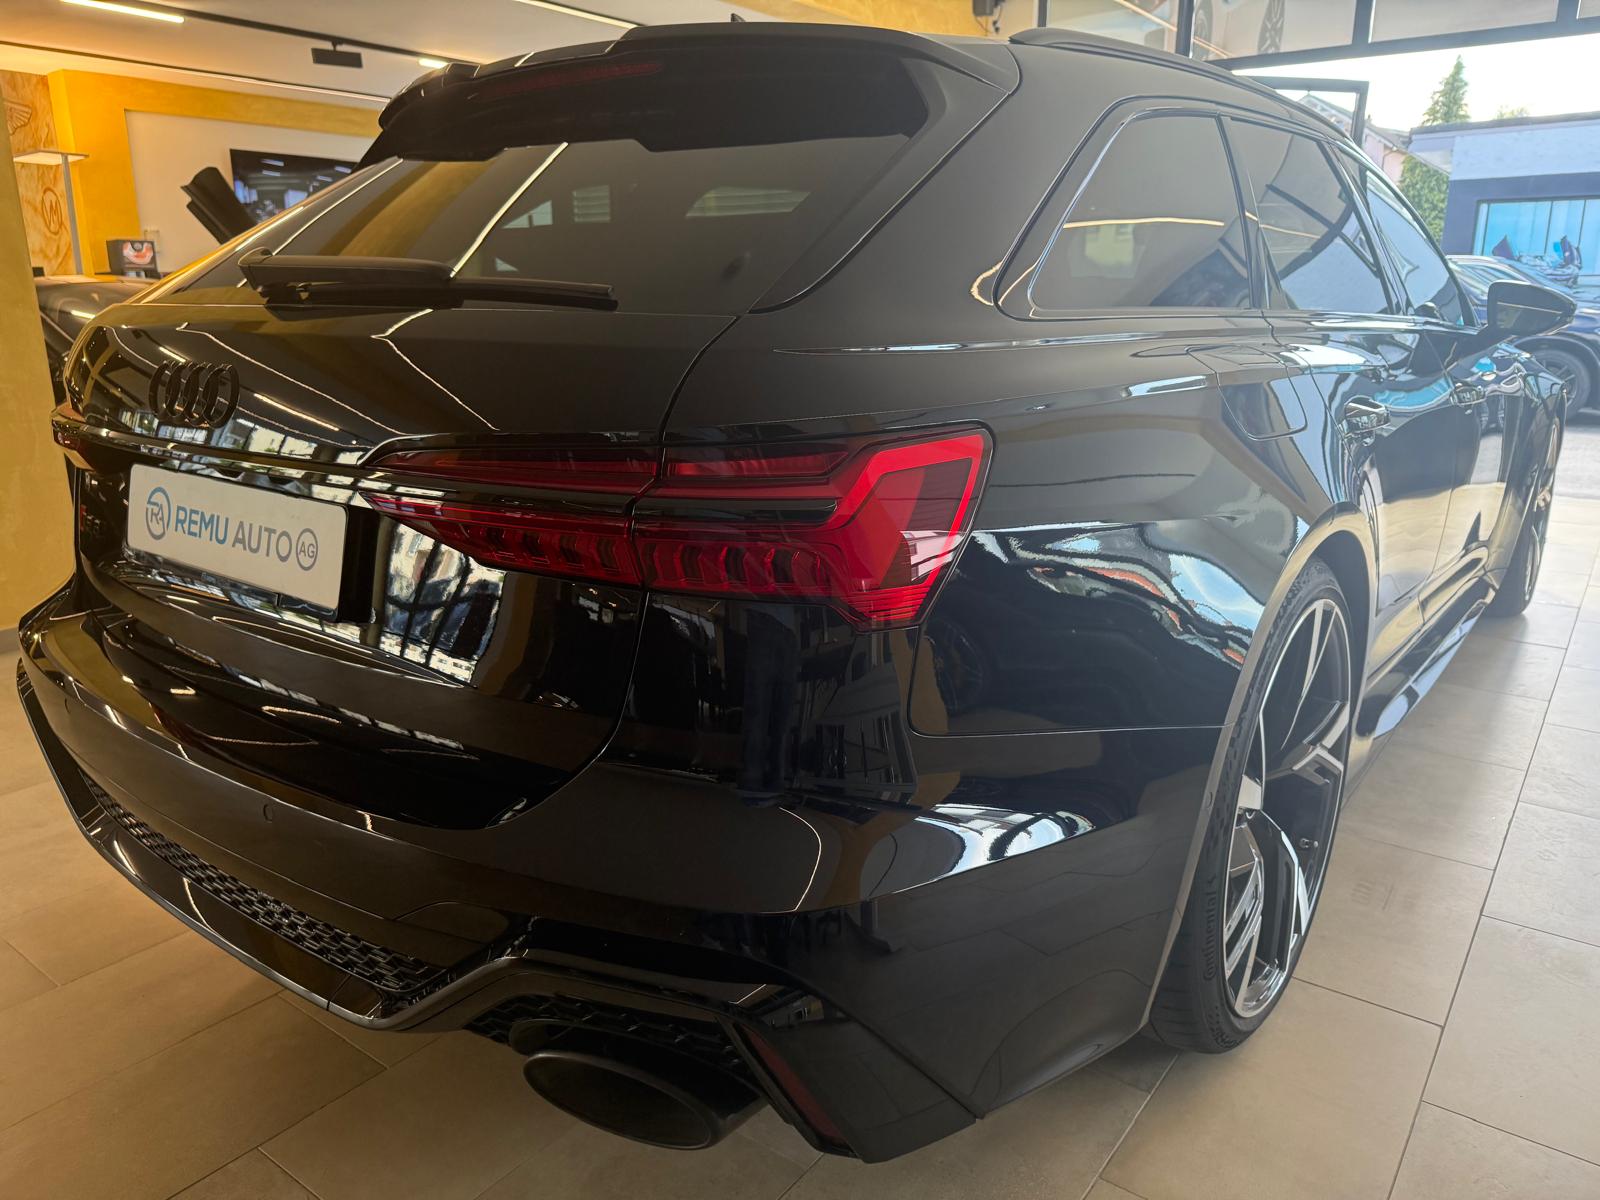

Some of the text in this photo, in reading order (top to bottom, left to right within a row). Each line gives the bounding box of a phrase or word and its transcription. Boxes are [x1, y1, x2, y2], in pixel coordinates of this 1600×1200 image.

[175, 505, 229, 545] REMU
[232, 520, 293, 563] AUTO
[298, 540, 316, 559] AG
[1203, 891, 1217, 982] Continental
